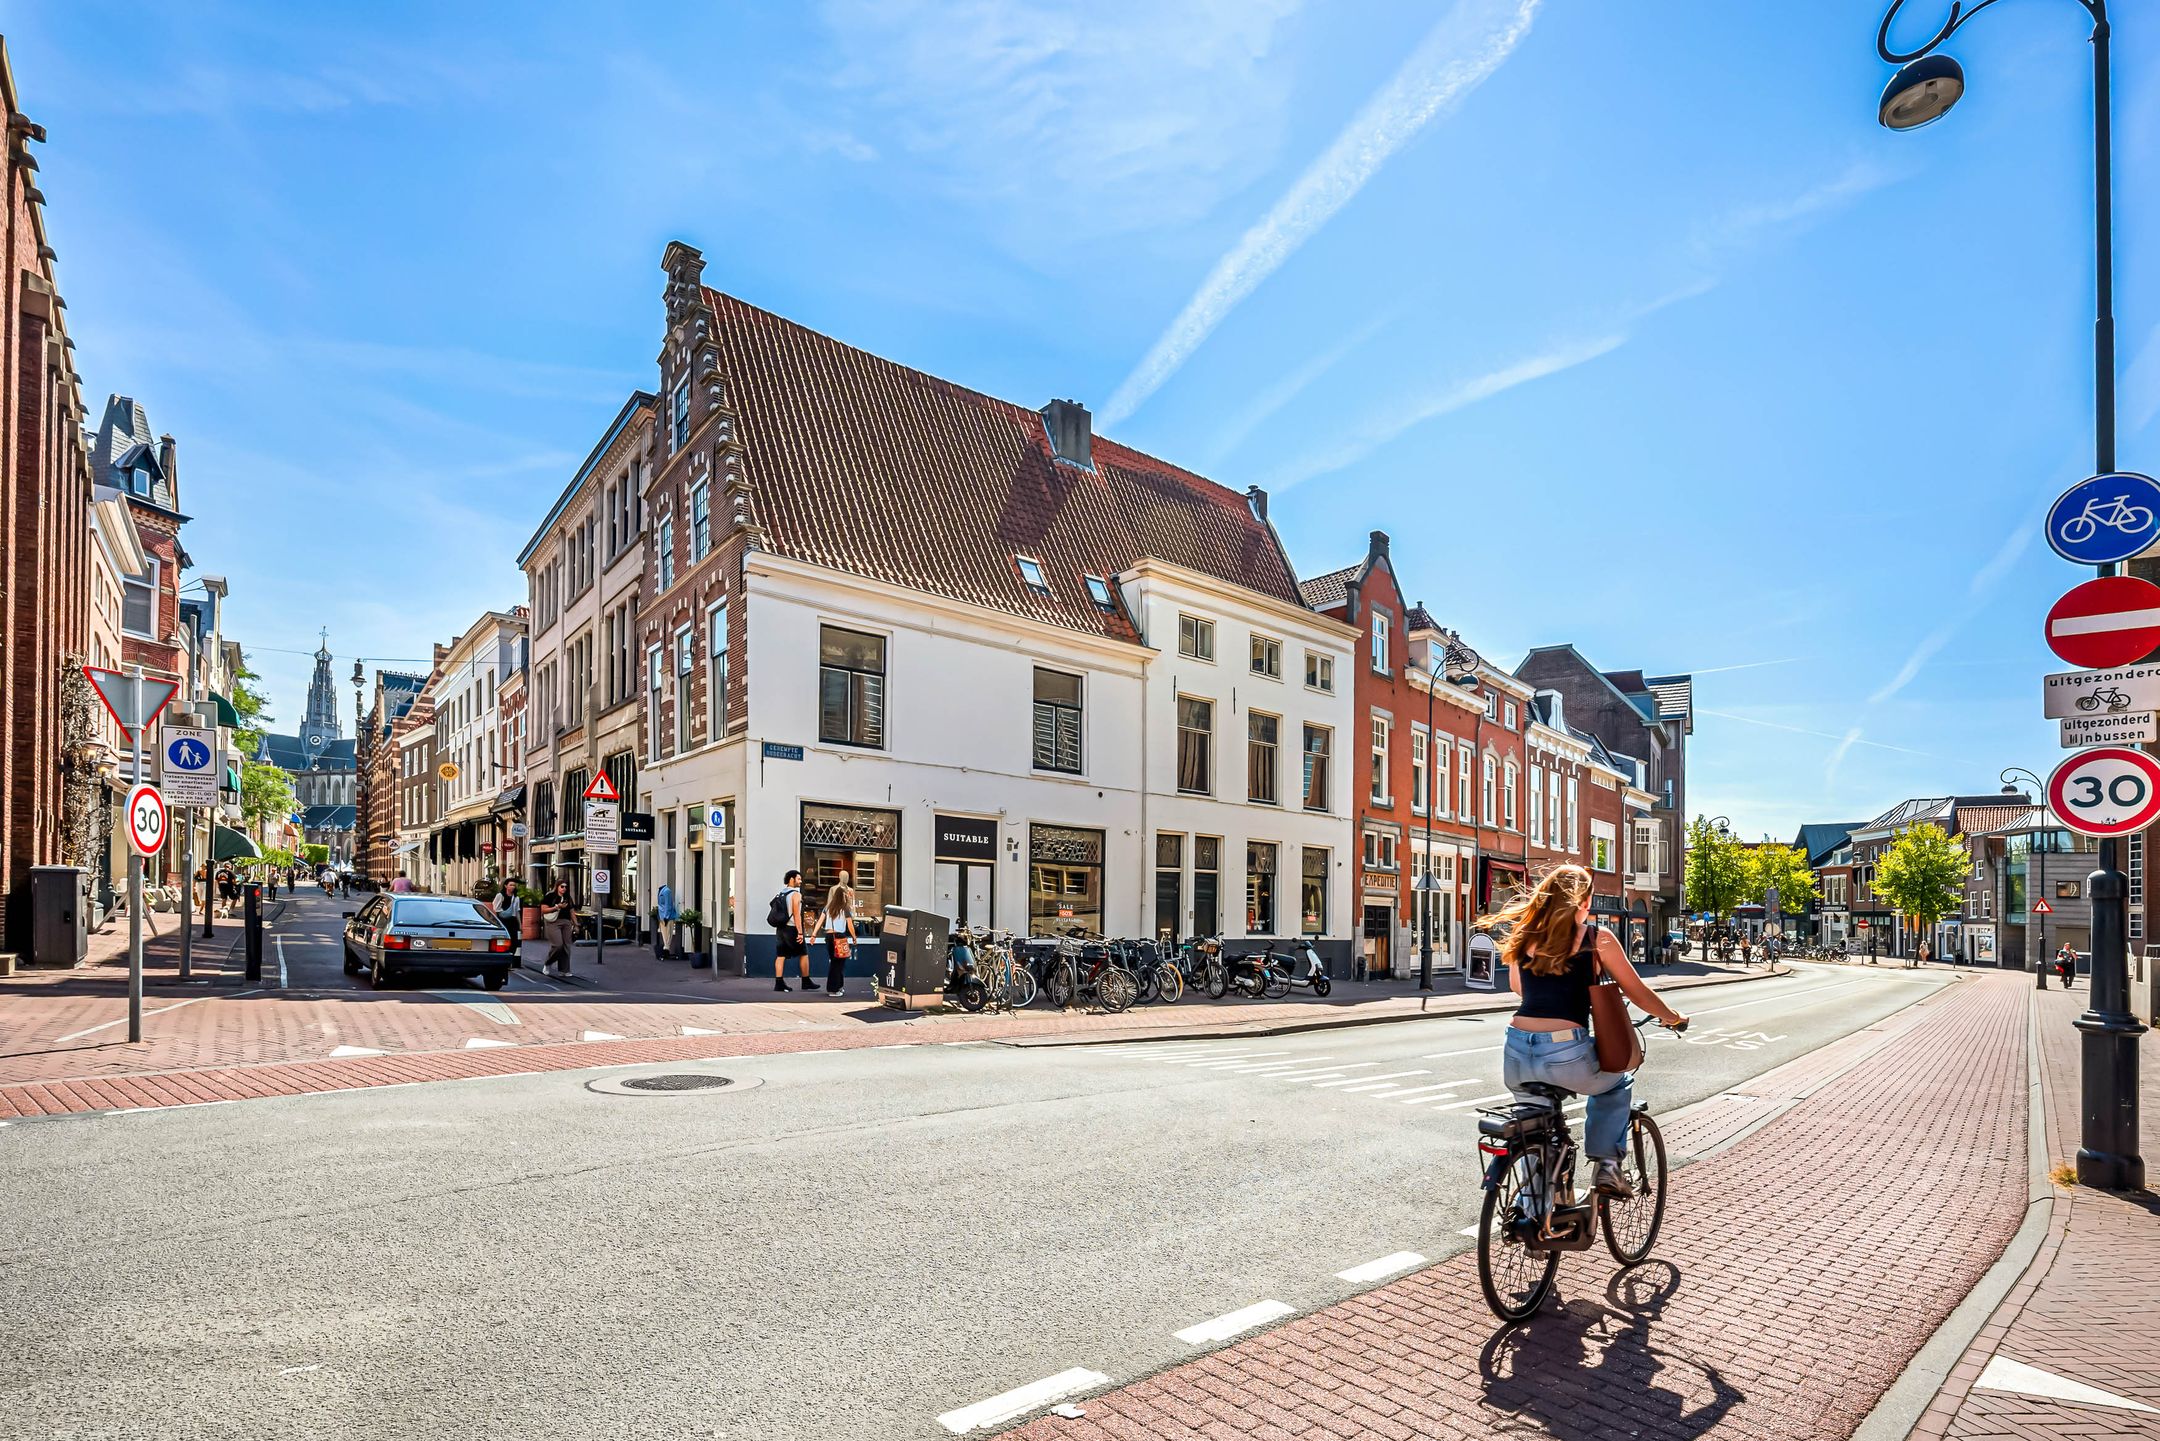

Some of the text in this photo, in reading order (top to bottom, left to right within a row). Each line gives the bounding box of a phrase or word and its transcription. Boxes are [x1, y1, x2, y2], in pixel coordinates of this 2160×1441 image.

[2064, 713, 2150, 731] uitgezonderd
[2068, 730, 2145, 746] lijnbussen
[2069, 775, 2146, 808] 30
[137, 807, 160, 834] 30
[943, 833, 989, 844] SUITABLE
[1365, 874, 1395, 887] EXPEDITIE
[1643, 1032, 1766, 1050] BUS
